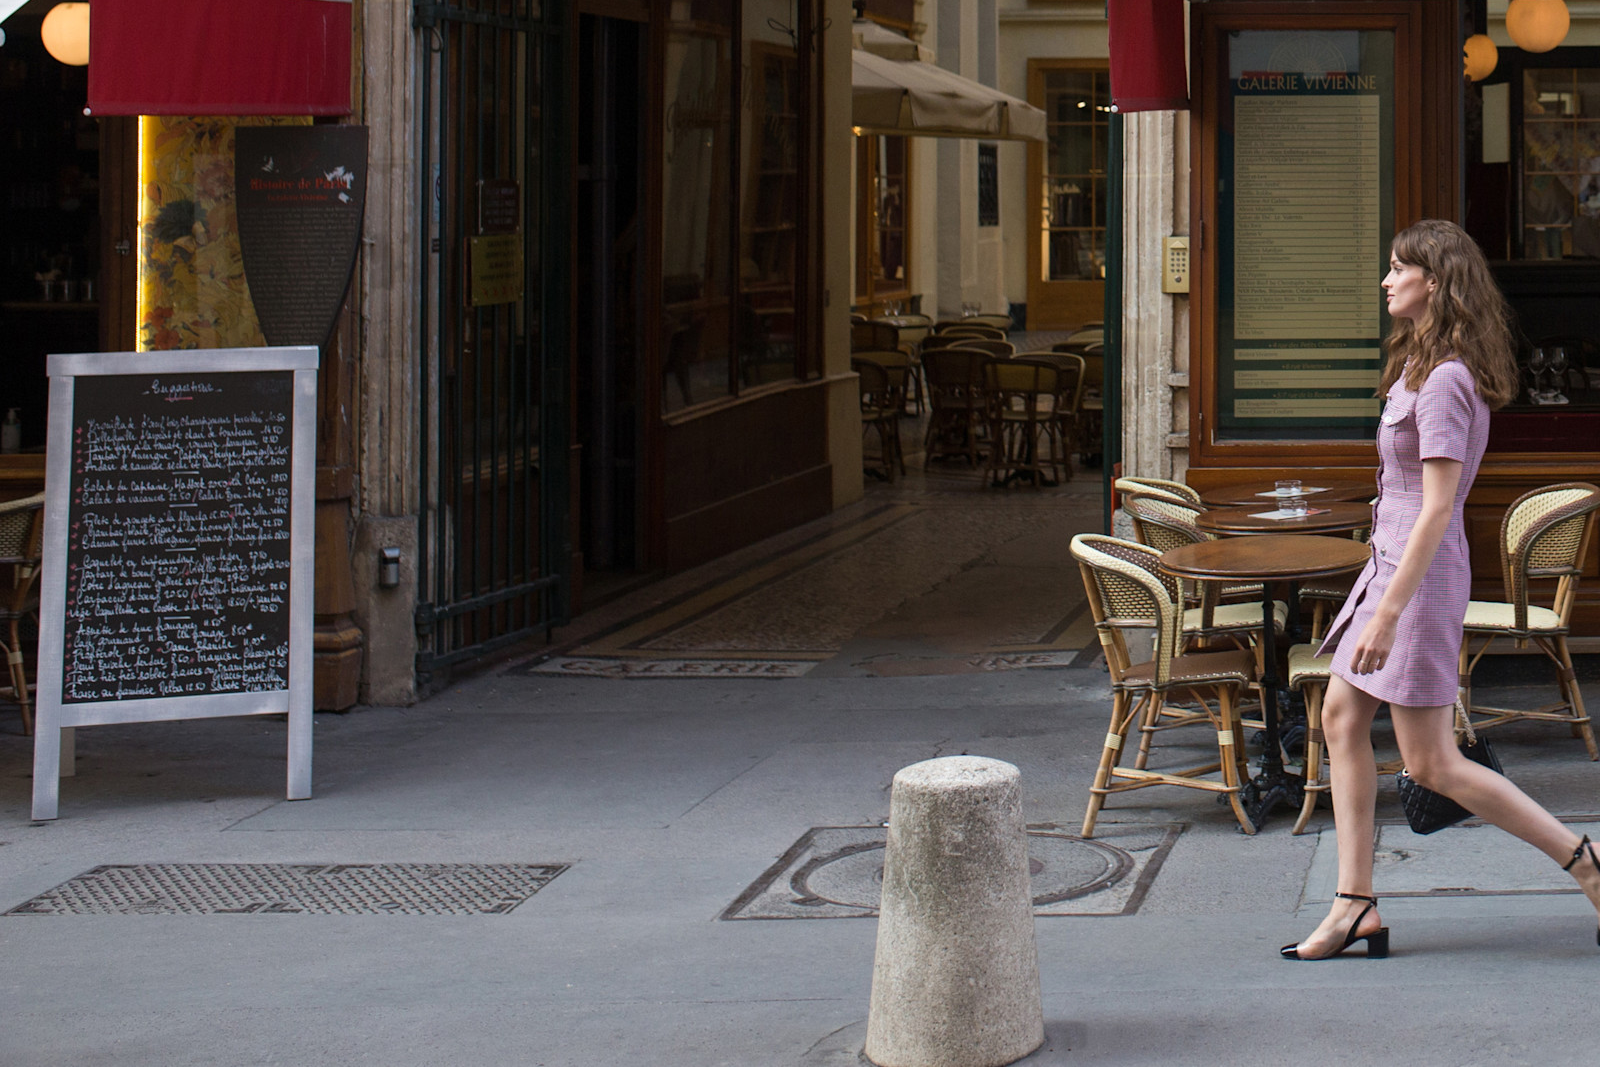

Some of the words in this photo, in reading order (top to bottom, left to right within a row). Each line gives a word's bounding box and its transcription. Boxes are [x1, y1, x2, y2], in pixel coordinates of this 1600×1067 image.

[1237, 75, 1298, 90] GALERIE
[1304, 75, 1376, 90] VIVIENNE
[249, 178, 294, 190] Histoire
[298, 178, 311, 189] de
